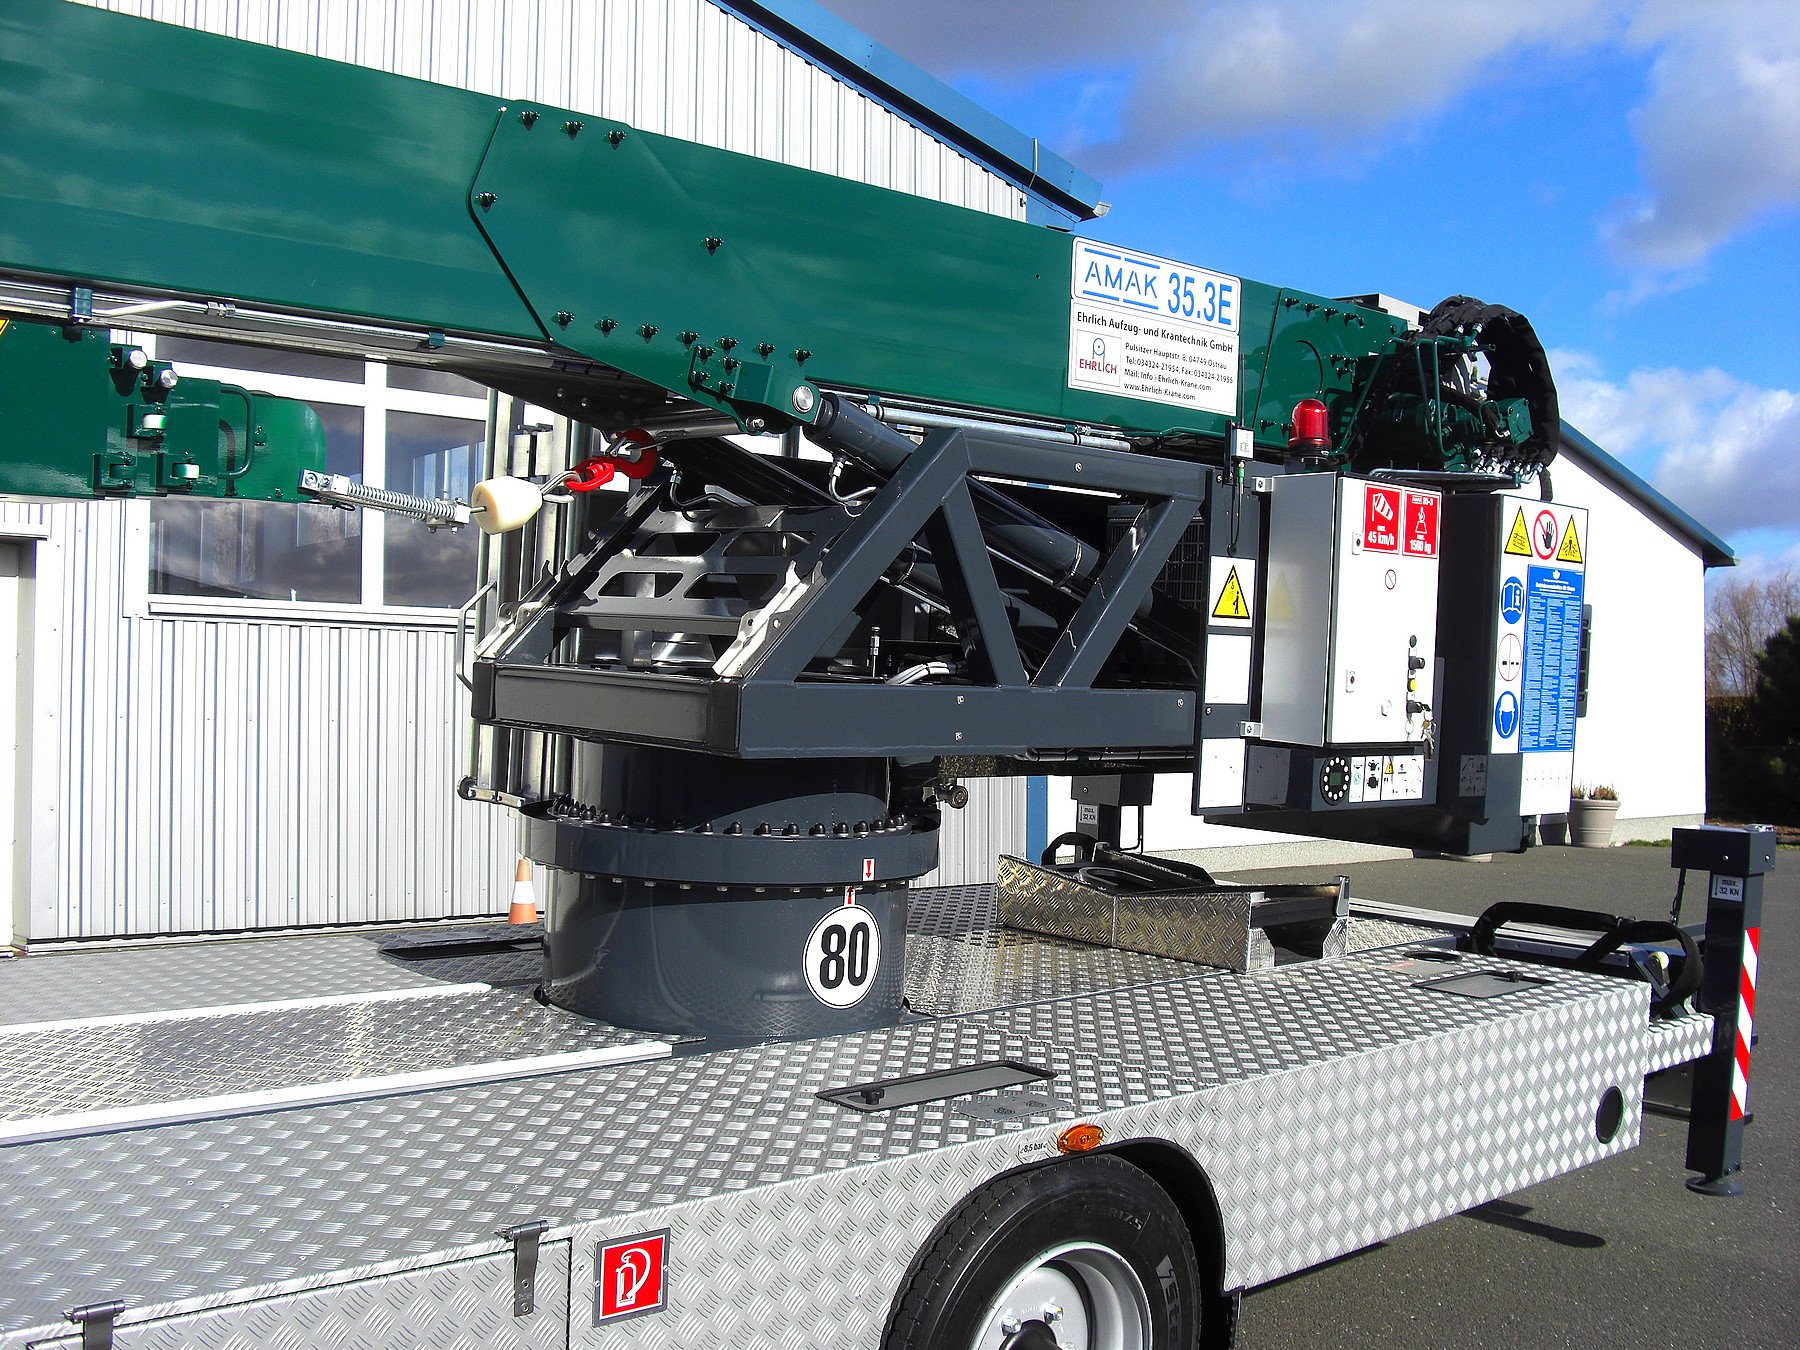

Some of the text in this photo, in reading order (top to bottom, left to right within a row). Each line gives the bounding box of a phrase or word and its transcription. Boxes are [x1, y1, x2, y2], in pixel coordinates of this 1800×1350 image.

[1085, 261, 1233, 326] AMAK 35.3E
[1077, 312, 1233, 353] Ehrlich Aufzug- und Krantechnik GmbH
[1126, 342, 1152, 354] Pulsitzer
[1188, 355, 1206, 365] 04749
[1208, 359, 1227, 370] Ostrau
[1079, 358, 1117, 374] EHRLICH
[1368, 530, 1394, 546] 45 km/h
[1424, 541, 1432, 555] kg
[1730, 888, 1739, 896] KN
[820, 922, 870, 989] 80
[1034, 1142, 1043, 1151] bar
